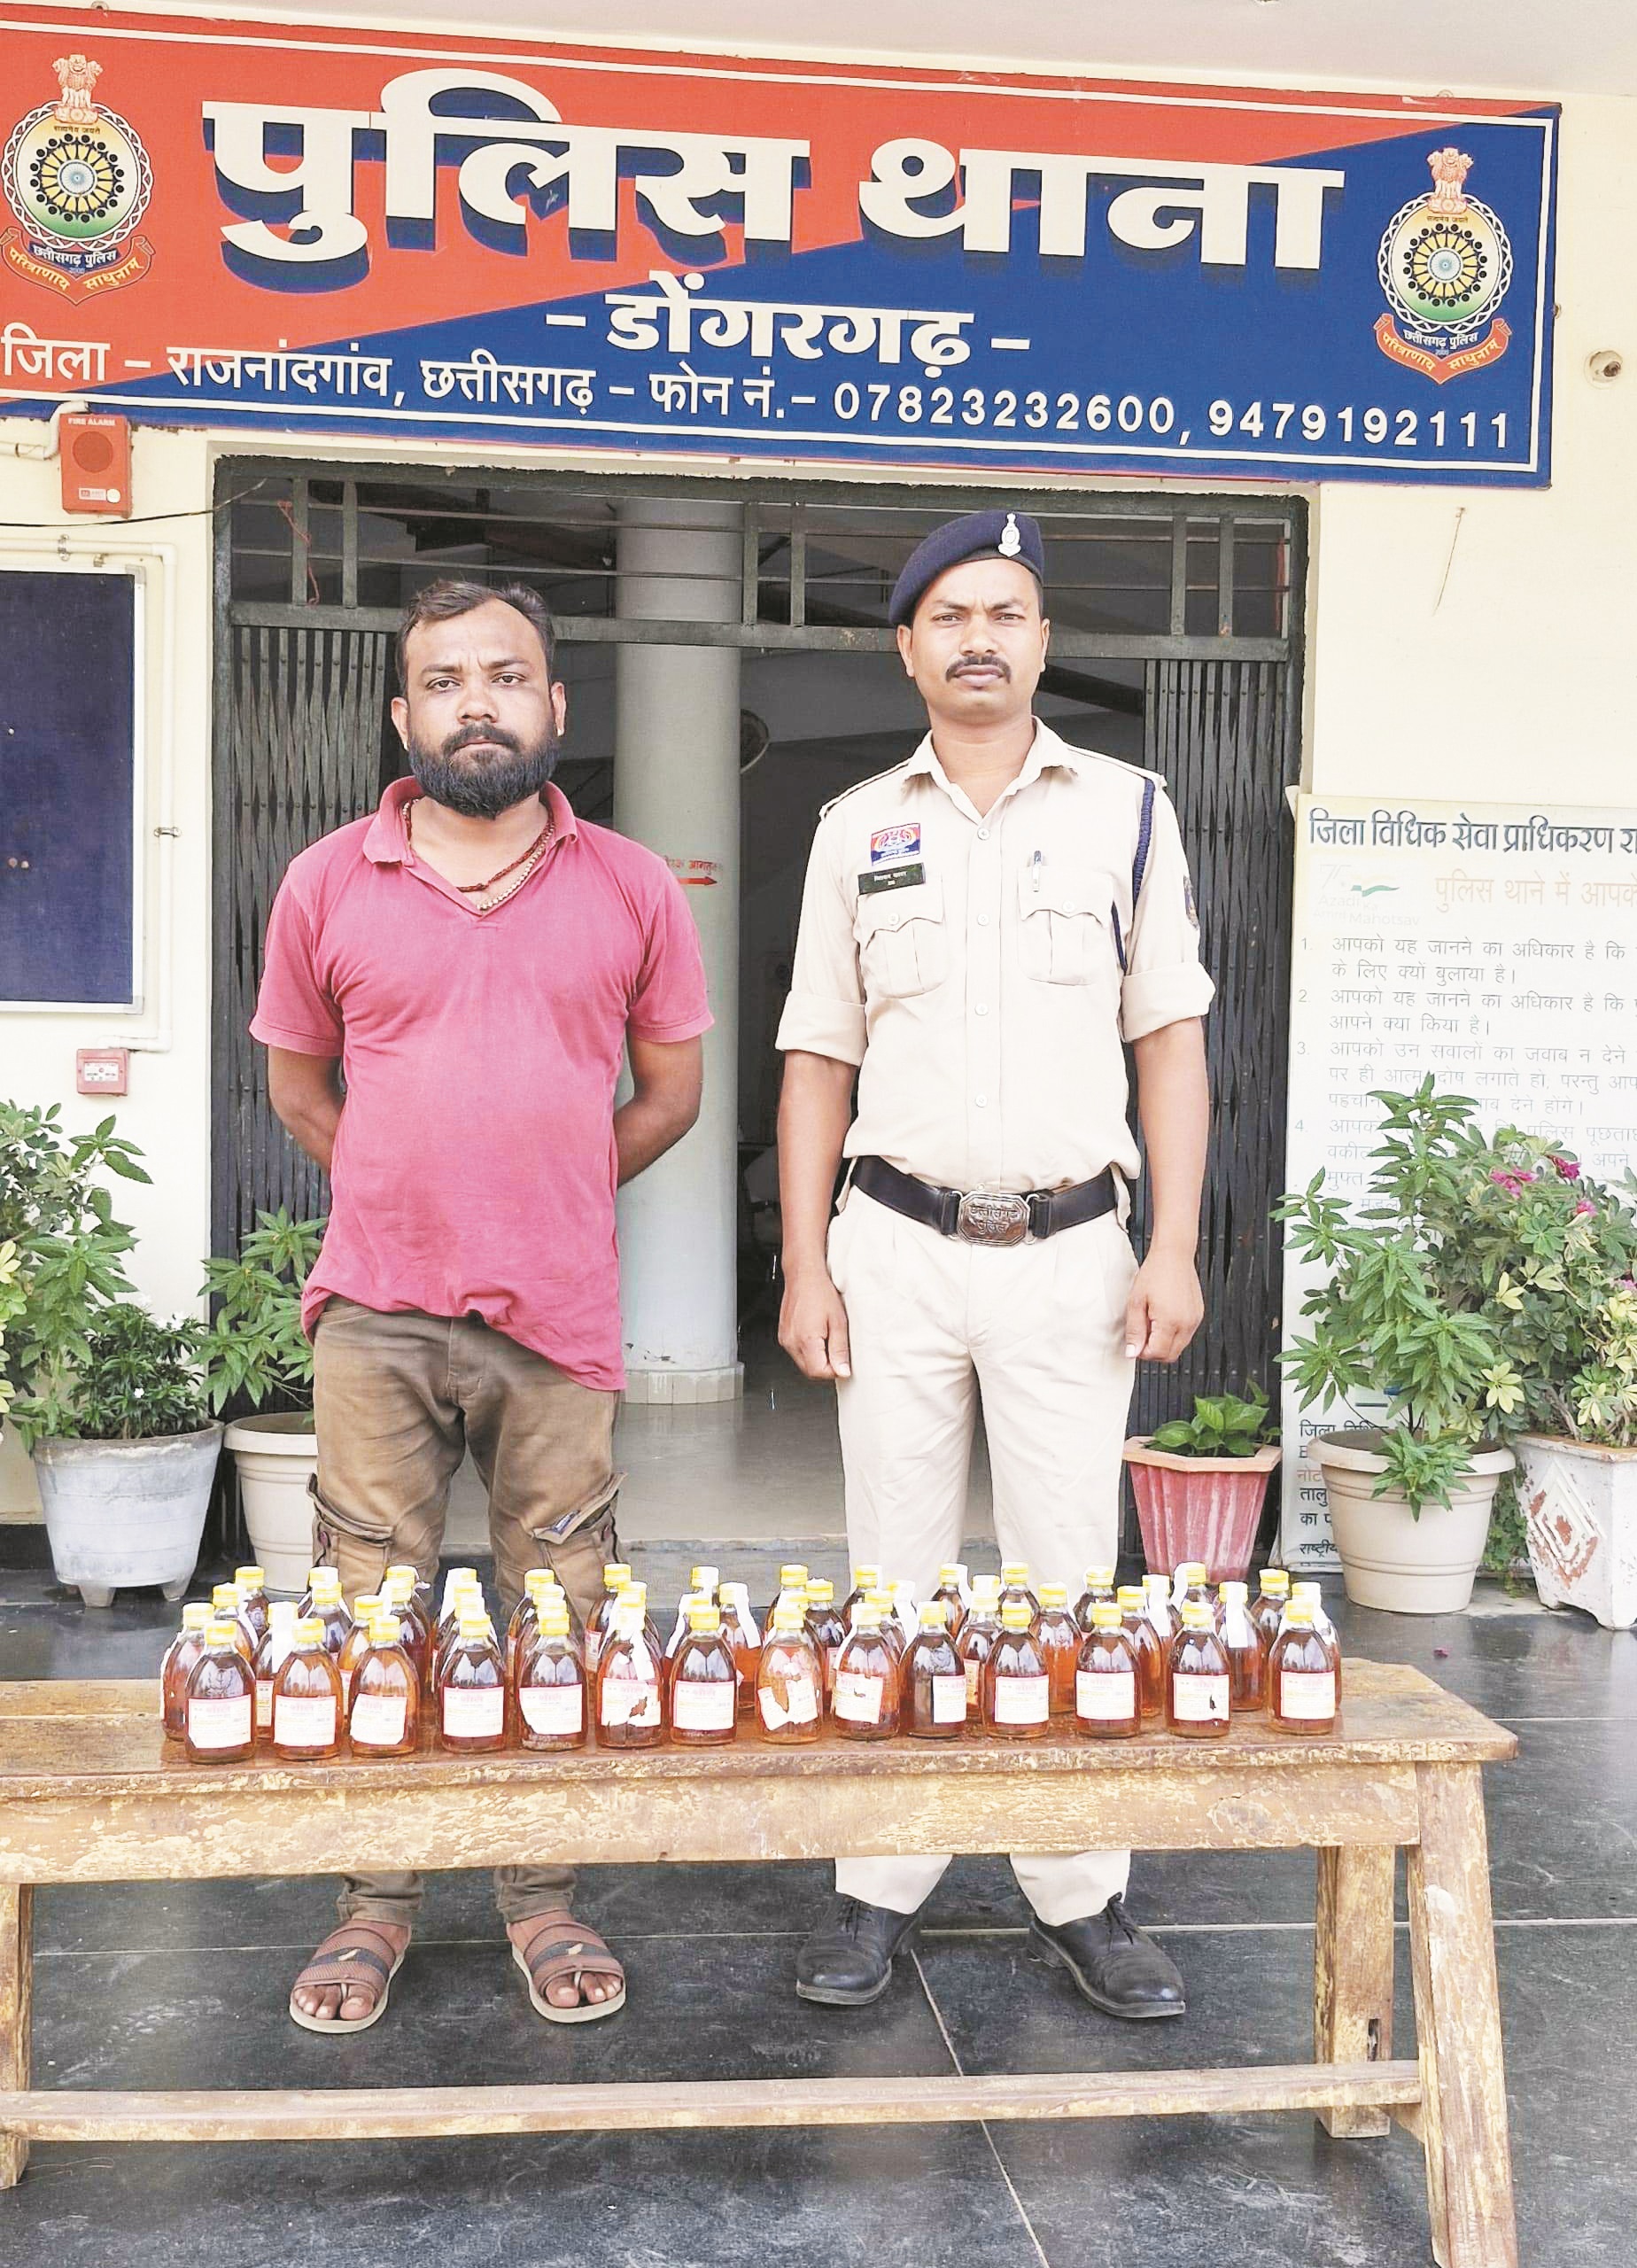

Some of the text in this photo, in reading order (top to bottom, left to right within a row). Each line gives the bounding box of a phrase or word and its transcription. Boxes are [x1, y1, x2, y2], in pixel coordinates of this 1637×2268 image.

[202, 67, 1345, 269] पुलिस थाना
[84, 250, 117, 268] पुलिस
[604, 271, 974, 378] डोंगरगढ़
[1449, 332, 1478, 349] पुलिस
[1, 322, 111, 381] जिला
[167, 340, 404, 408] राजनांदगांव,
[422, 349, 596, 416] छत्तीसगढ़
[648, 361, 733, 416] फोन
[834, 382, 1190, 446] 07823232600,
[1208, 398, 1510, 450] 9479192111
[68, 417, 115, 427] FIRE ALARM
[1309, 808, 1367, 845] जिला
[1371, 810, 1447, 848] विधिक
[1452, 812, 1499, 850] सेवा
[1502, 814, 1615, 853] प्राधिकरण
[1435, 868, 1494, 913] पुलिस
[1505, 870, 1545, 905] थाने
[1555, 870, 1571, 905] में
[1300, 933, 1626, 960] 1. आपको यह जानने का अधिकार है कि
[1331, 959, 1347, 977] के
[1356, 959, 1388, 981] लिए
[1397, 961, 1427, 980] क्यों
[1435, 965, 1485, 986] बुलाया
[1331, 985, 1383, 1005] आपको
[1392, 990, 1417, 1006] यह
[1424, 988, 1471, 1007] जानने
[1481, 994, 1503, 1009] का
[1510, 990, 1573, 1011] अधिकार
[1582, 991, 1594, 1013] है
[1603, 992, 1625, 1012] कि
[1329, 1011, 1373, 1031] आपने
[1382, 1017, 1410, 1032] क्या
[1421, 1013, 1460, 1033] किया
[1330, 1037, 1385, 1057] आपको
[1393, 1044, 1420, 1059] उन
[1431, 1040, 1484, 1060] सवालों
[1493, 1047, 1516, 1061] का
[1524, 1047, 1570, 1063] जवाब
[1578, 1049, 1593, 1064] न
[1601, 1044, 1627, 1065] देने
[1330, 1068, 1349, 1082] पर
[1358, 1063, 1375, 1084] ही
[1474, 1068, 1521, 1087] लगाते
[1560, 1074, 1600, 1095] परन्तु
[1509, 1095, 1534, 1113] देने
[1300, 1512, 1318, 1526] का
